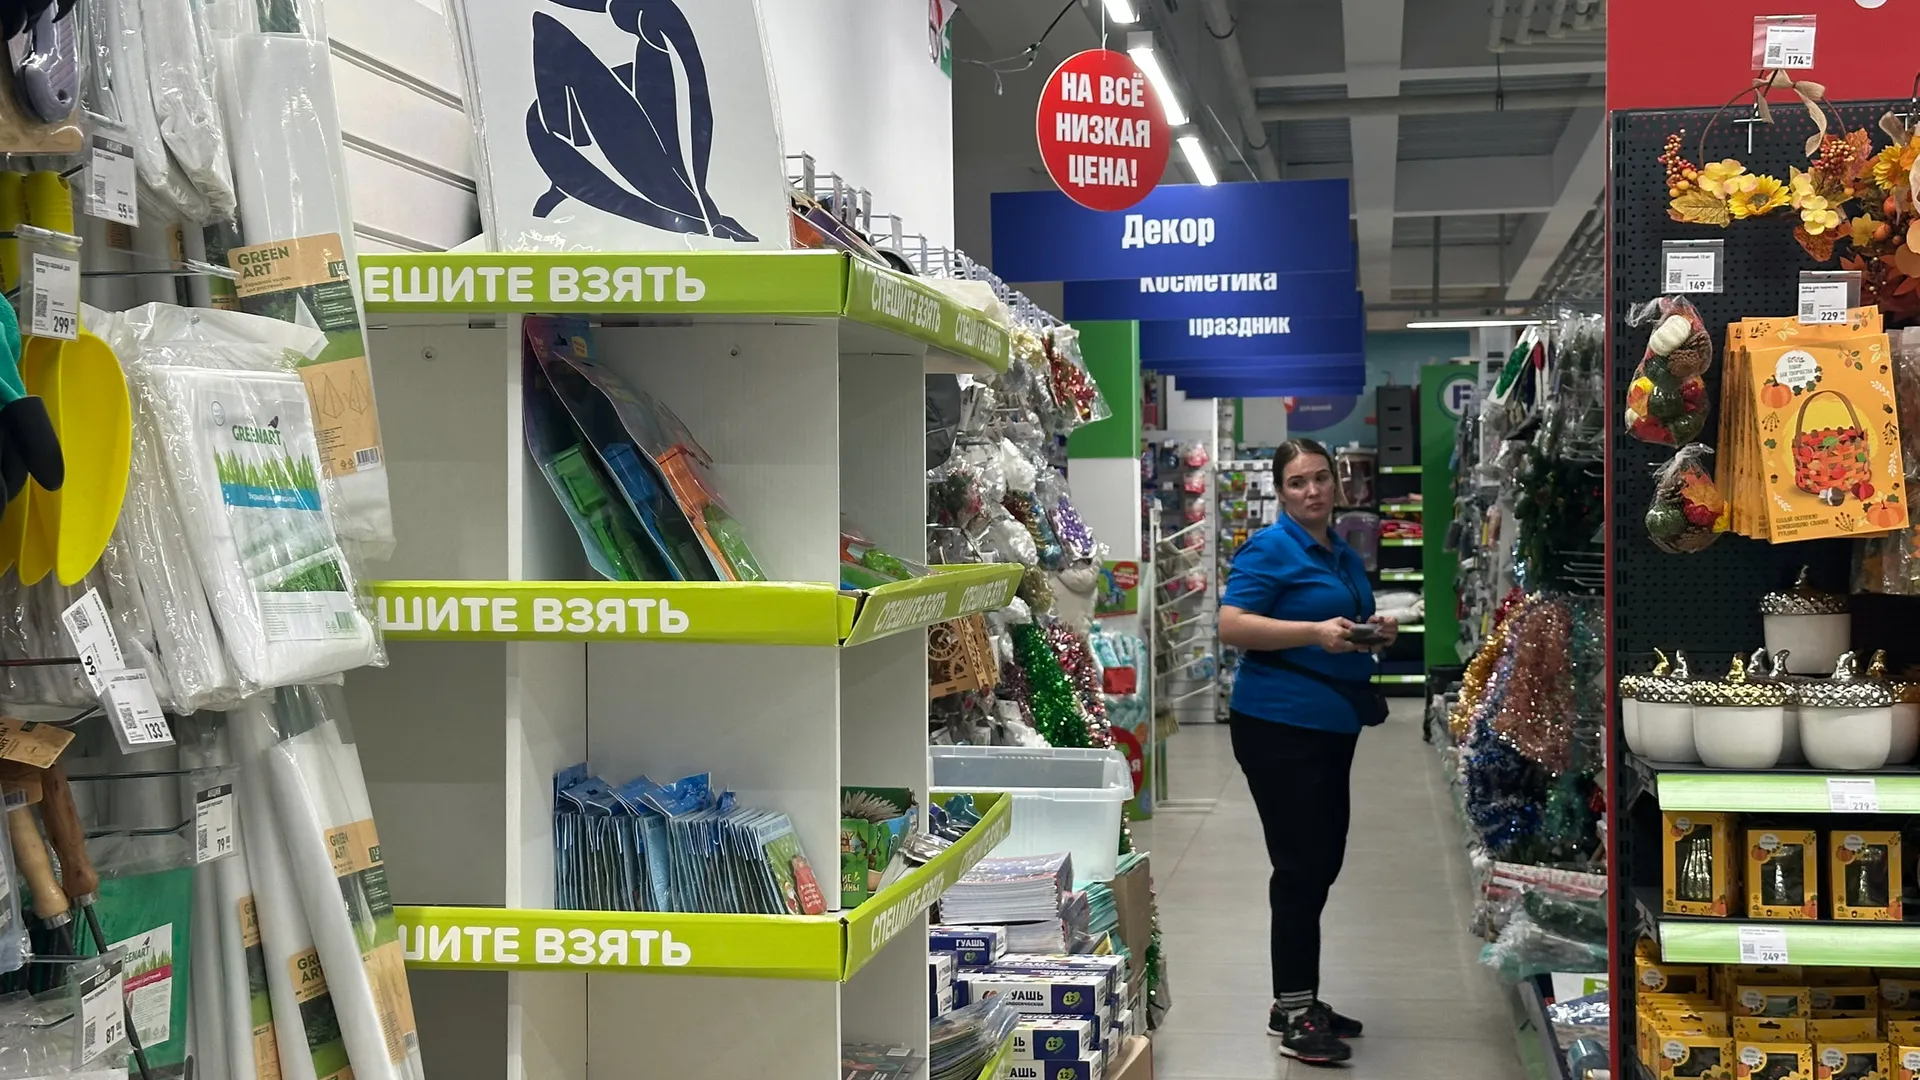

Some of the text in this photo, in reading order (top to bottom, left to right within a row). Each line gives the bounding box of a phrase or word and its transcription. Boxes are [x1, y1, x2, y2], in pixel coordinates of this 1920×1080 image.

[1788, 55, 1804, 65] 174
[1061, 72, 1145, 107] НА ВСЁ
[1056, 113, 1150, 148] НИЗКАЯ
[1068, 155, 1137, 187] ЦЕНА!
[1121, 214, 1215, 248] Декор
[237, 246, 289, 265] GREEN
[242, 263, 272, 279] ART
[364, 266, 705, 302] ЕШИТЕ ВЗЯТЬ
[1689, 281, 1706, 290] 149
[871, 275, 941, 333] СПЕШИТЕ ВЗЯТЬ
[54, 315, 69, 334] 299
[1821, 311, 1838, 321] 229
[1189, 317, 1290, 338] Праздник
[232, 425, 281, 445] GREENART
[377, 596, 689, 633] ШИТЕ ВЗЯТЬ
[873, 591, 948, 633] СПЕШИТЕ ВЗЯТЬ
[85, 656, 96, 676] 99
[144, 722, 163, 739] 133
[1852, 801, 1869, 811] 279
[217, 837, 225, 852] 79
[871, 887, 921, 951] СПЕШИТЕ
[398, 924, 691, 966] ШИТЕ ВЗЯТЬ
[956, 939, 985, 947] ГУАШЬ
[125, 946, 150, 963] EENART
[1762, 952, 1779, 961] 249
[1011, 990, 1044, 1001] УАШЬ
[106, 1025, 115, 1044] 87
[1048, 1040, 1058, 1048] 12
[1009, 1067, 1037, 1078] АШЬ
